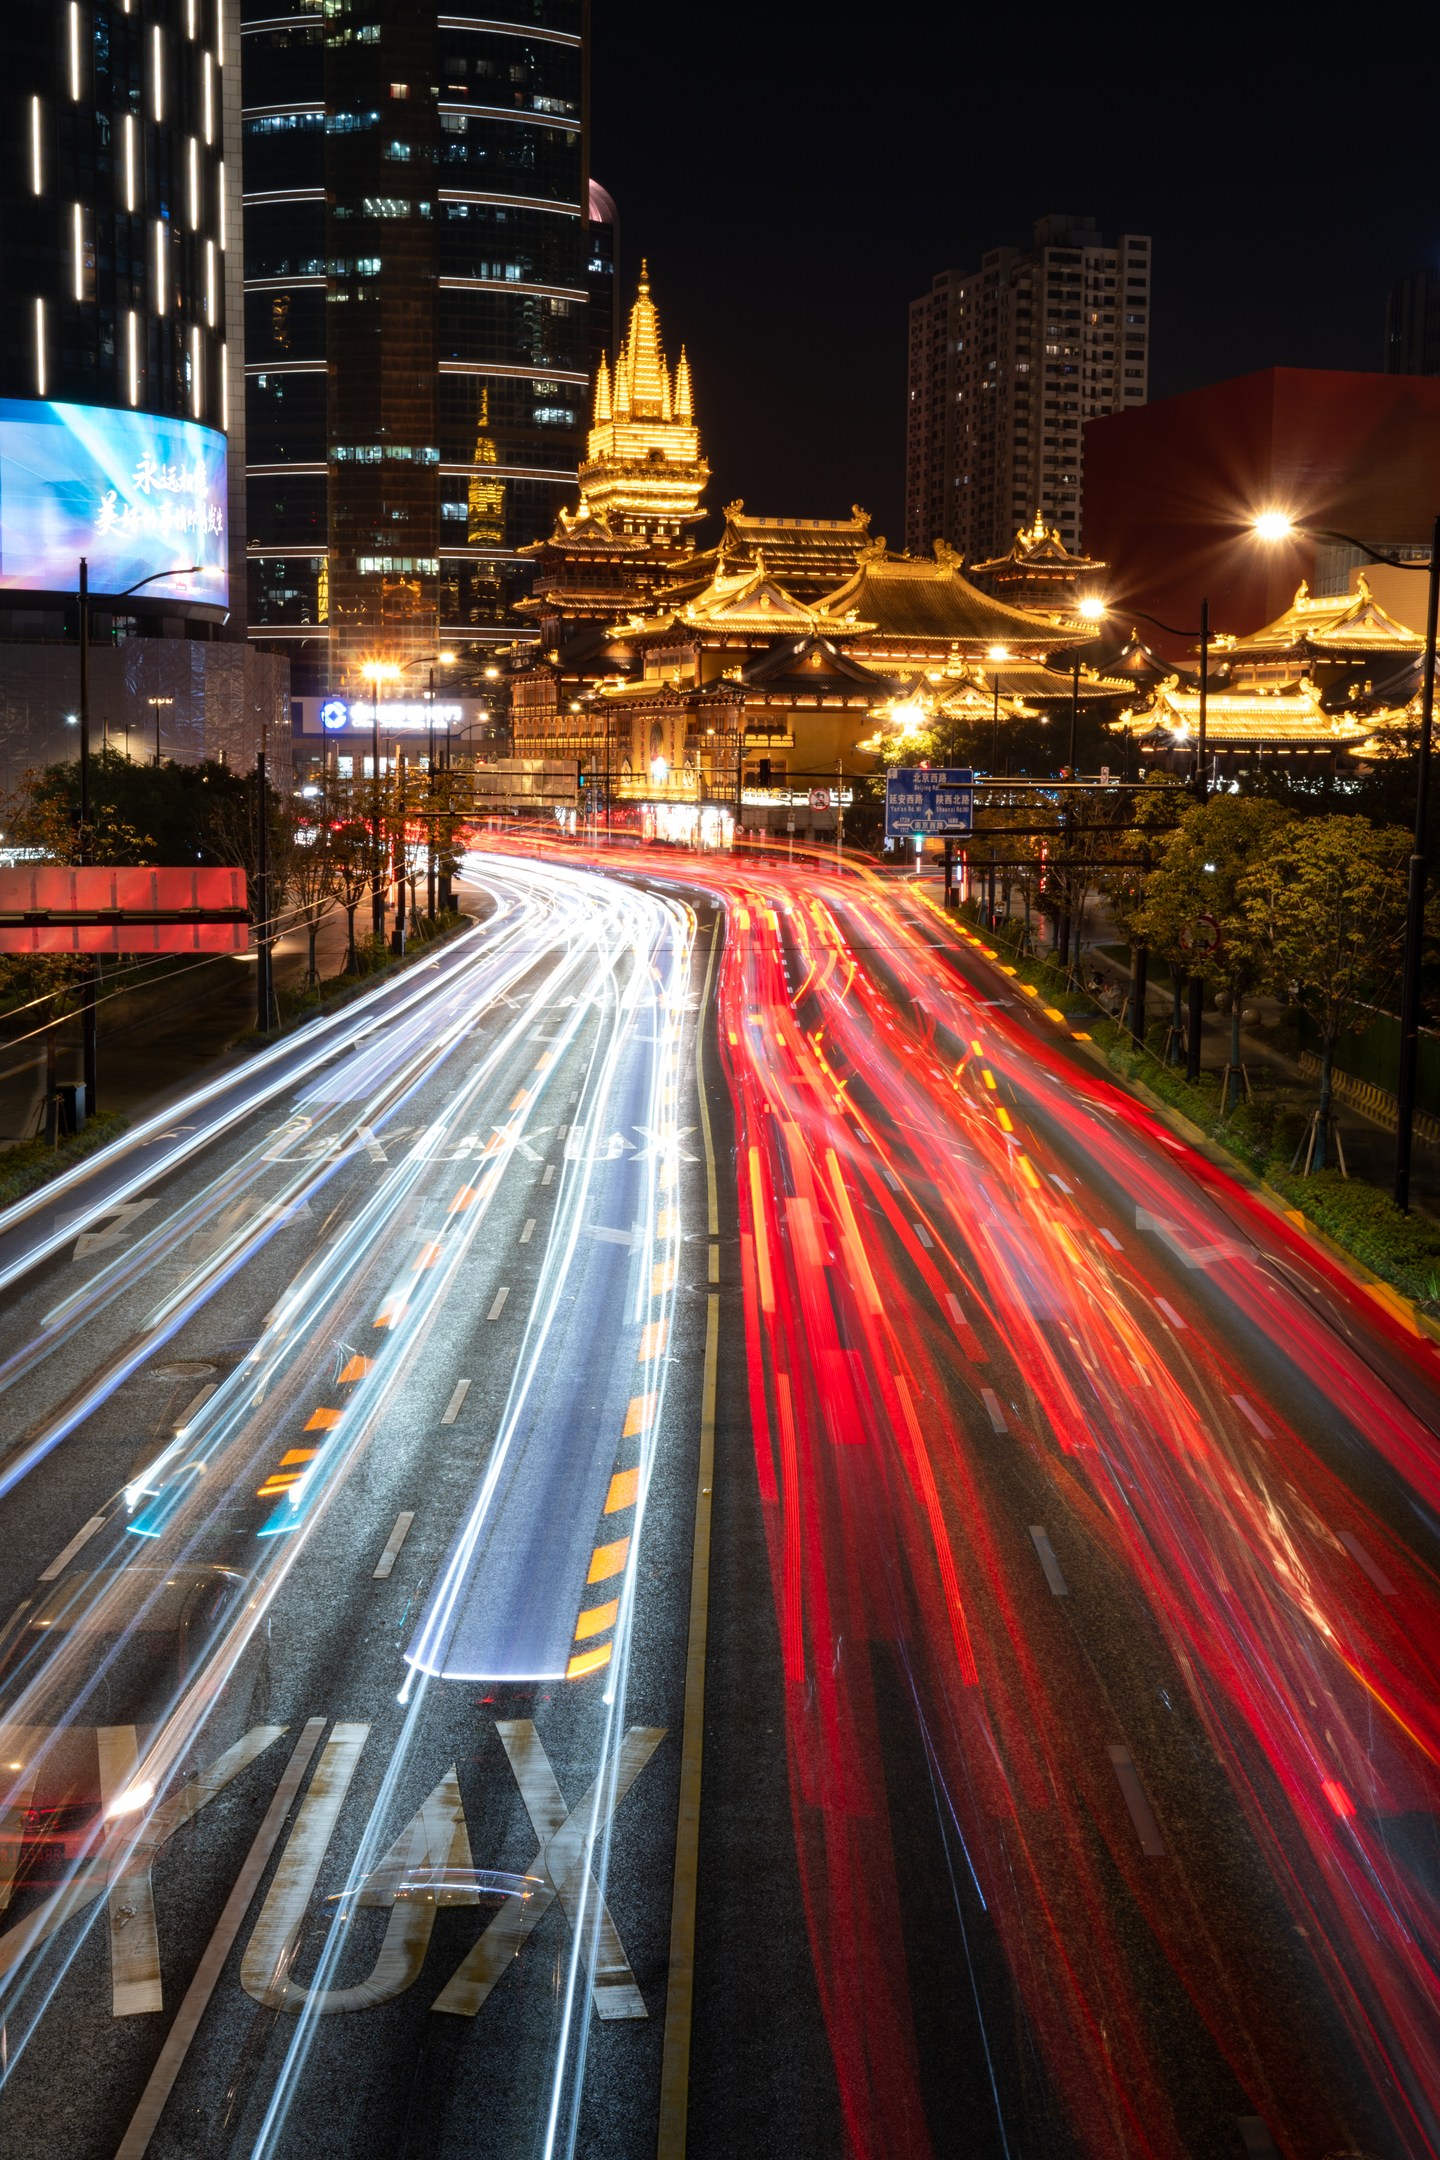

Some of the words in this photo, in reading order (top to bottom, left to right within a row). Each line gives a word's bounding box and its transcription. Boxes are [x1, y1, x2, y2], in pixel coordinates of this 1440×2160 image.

[913, 773, 947, 783] 北京西路
[889, 794, 923, 805] 延安西路
[935, 794, 970, 805] 陕西北路
[914, 822, 943, 830] 南京西路
